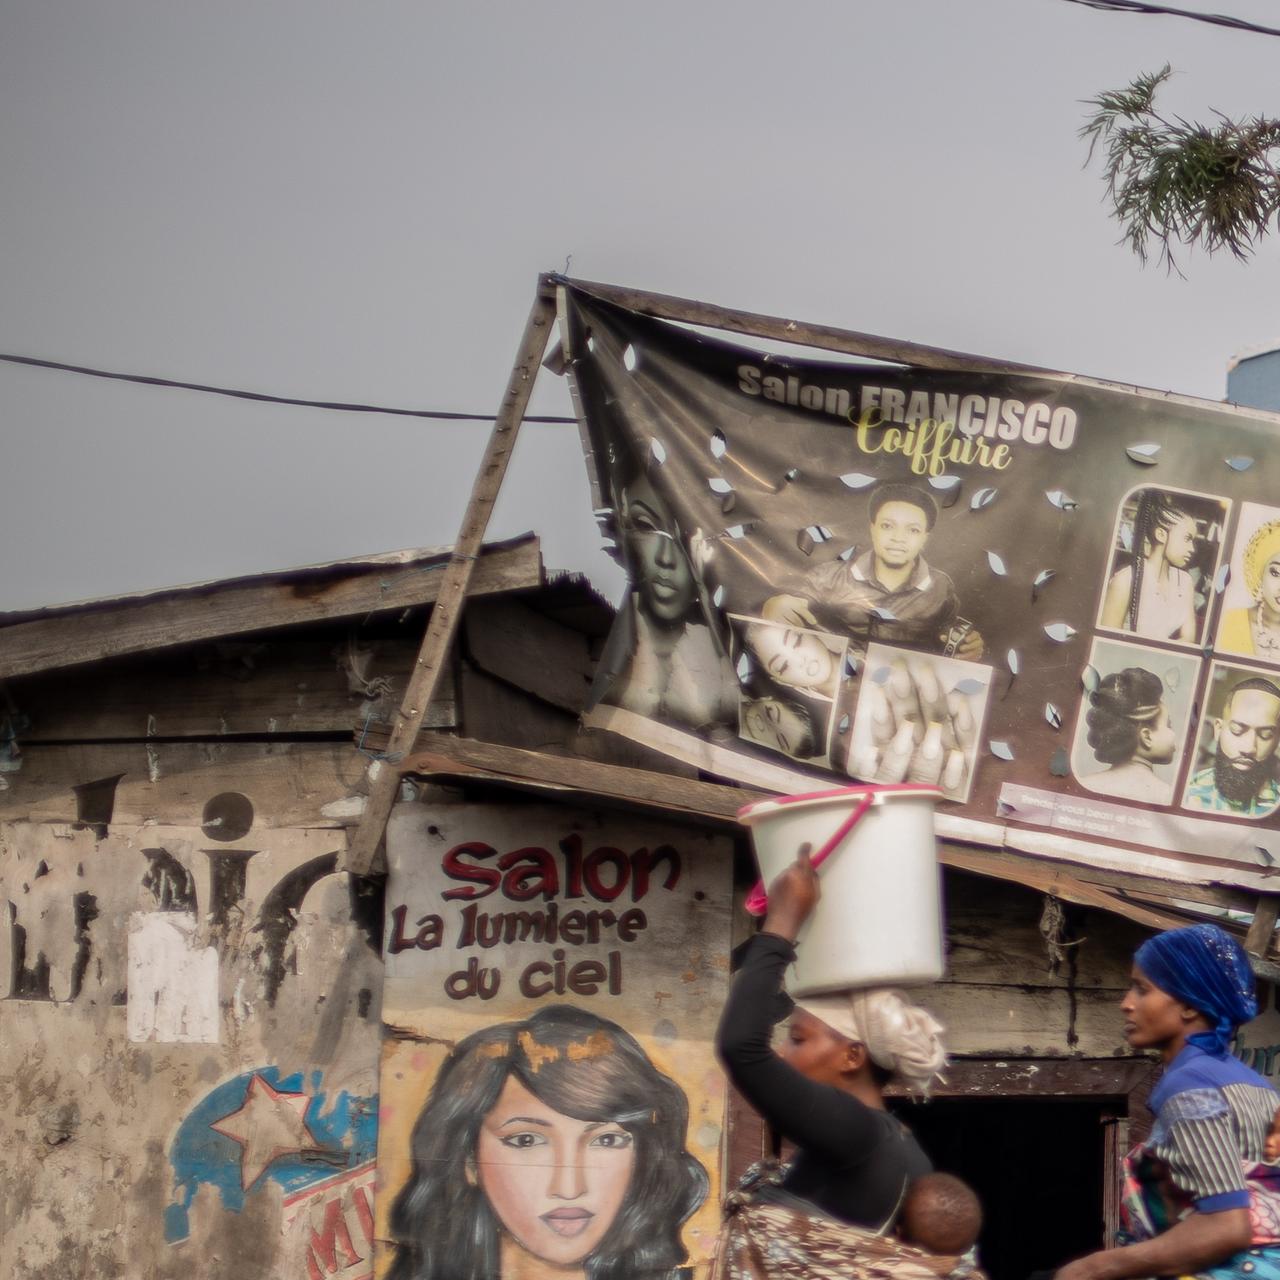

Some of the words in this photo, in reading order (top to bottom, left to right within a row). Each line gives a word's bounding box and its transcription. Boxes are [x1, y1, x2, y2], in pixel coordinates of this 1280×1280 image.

[737, 364, 850, 418] Salon
[848, 405, 1013, 478] Coiffure
[441, 833, 683, 903] Salon
[388, 904, 445, 955] La
[444, 956, 501, 1001] du
[519, 949, 623, 999] ciel
